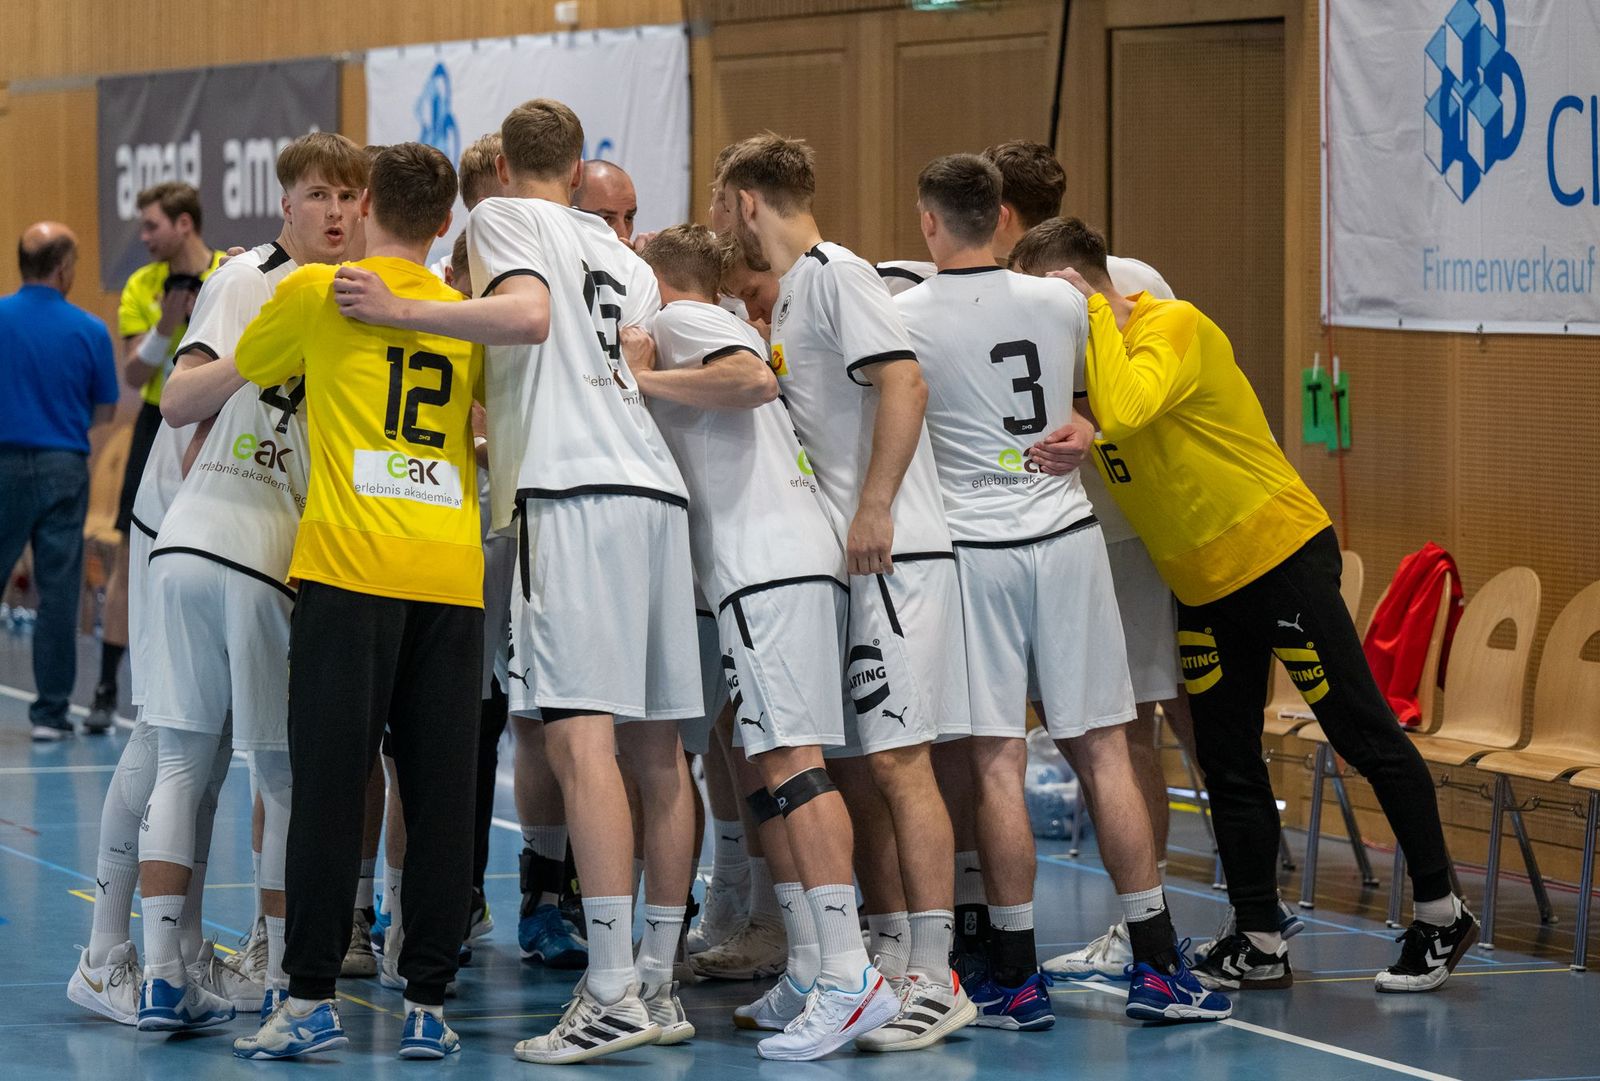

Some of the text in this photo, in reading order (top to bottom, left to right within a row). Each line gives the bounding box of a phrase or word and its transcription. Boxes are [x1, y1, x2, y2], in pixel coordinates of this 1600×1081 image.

[1423, 244, 1595, 293] Firmenverkauf
[386, 345, 454, 449] 12
[990, 339, 1048, 435] 3
[1306, 383, 1322, 429] T
[232, 433, 294, 473] eak
[386, 453, 441, 486] eak
[1094, 443, 1132, 484] 16
[354, 483, 402, 496] erlebnis
[404, 486, 454, 505] akademie
[971, 475, 1019, 489] erlebnis
